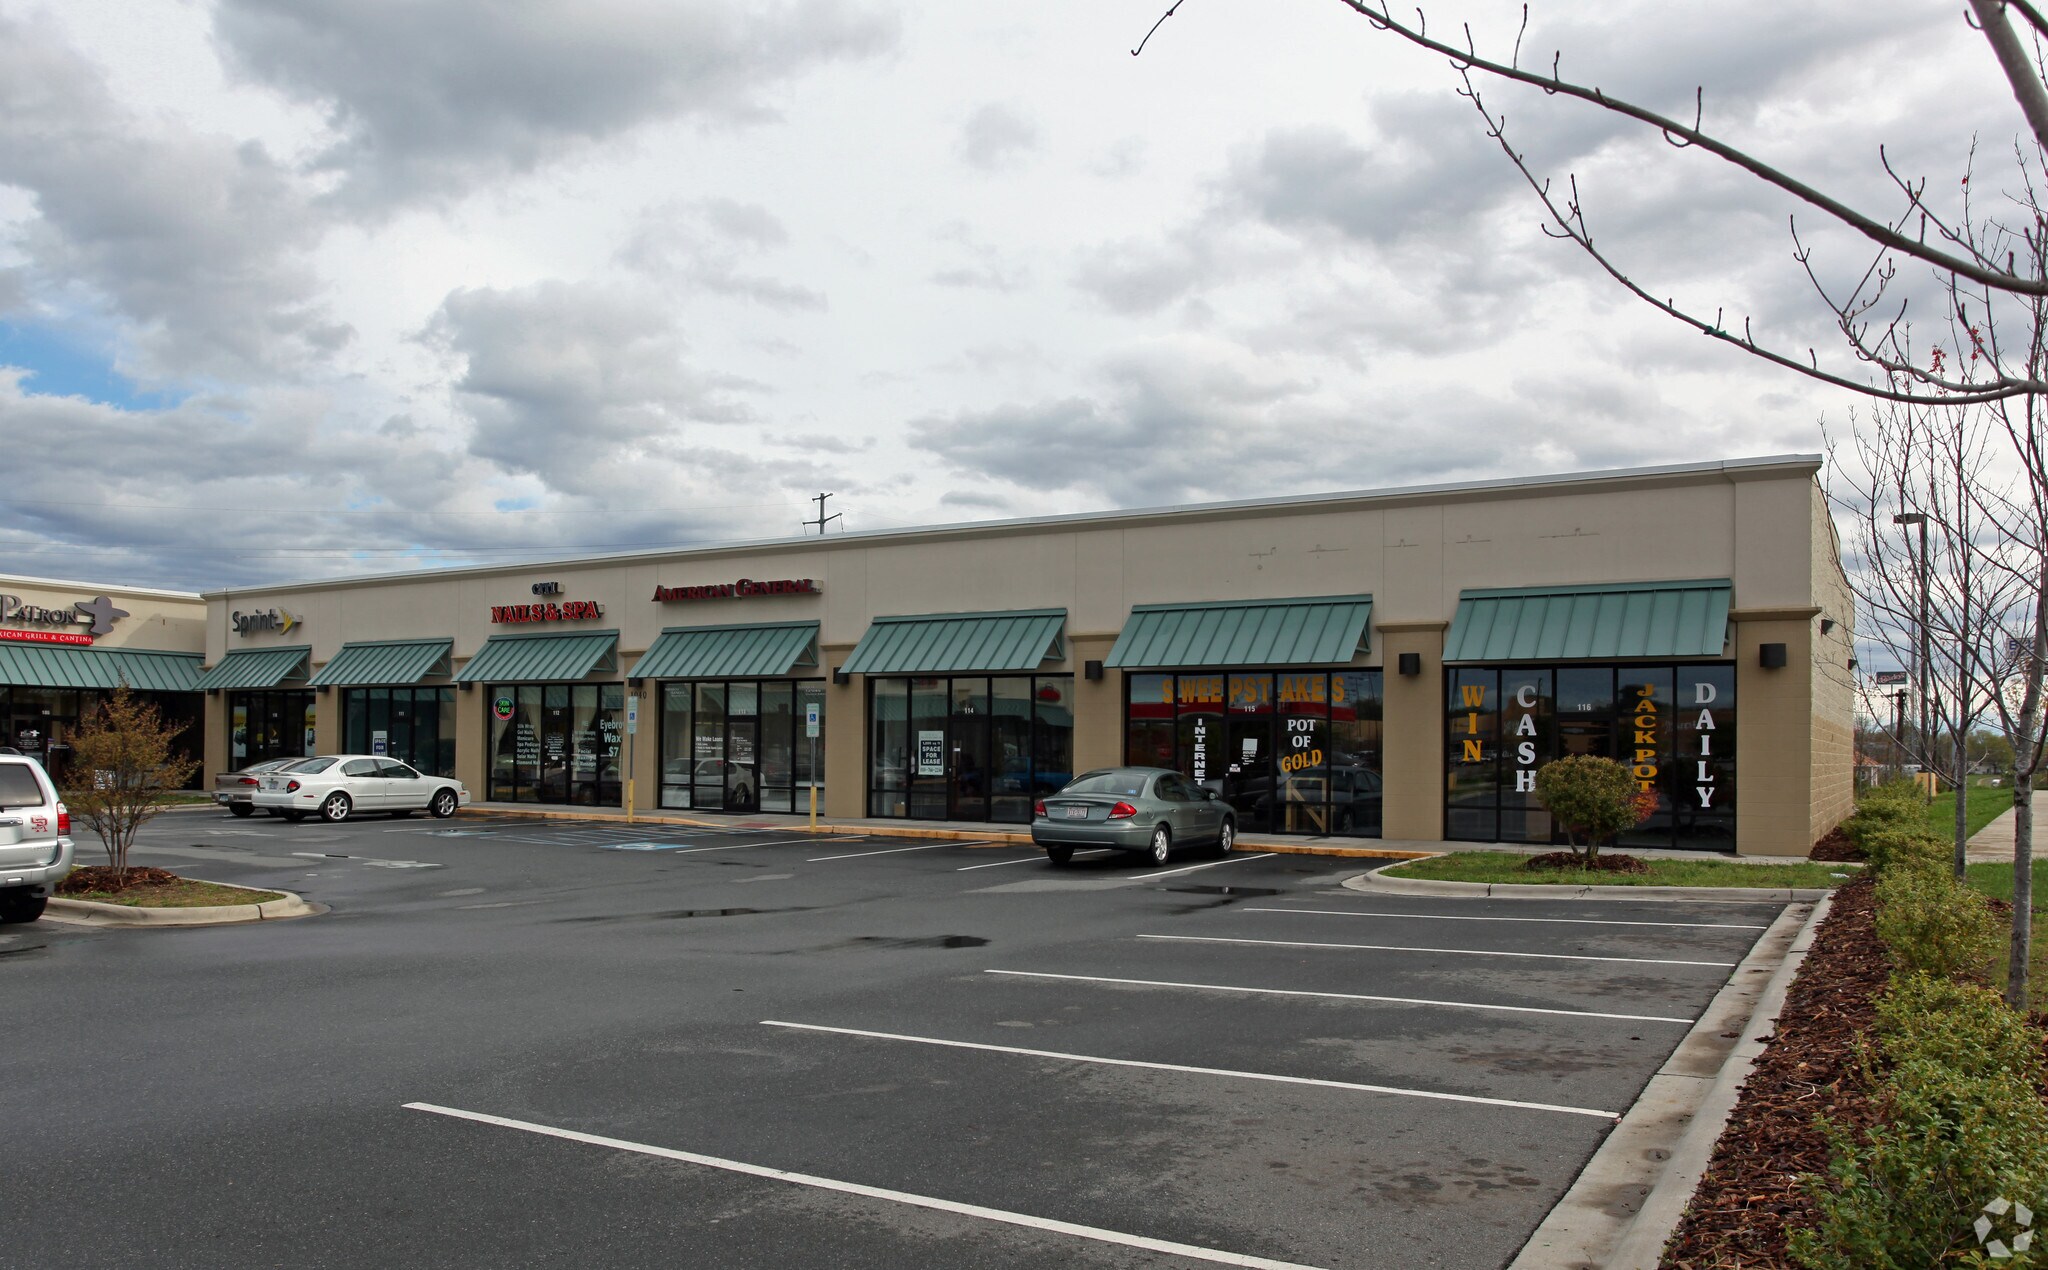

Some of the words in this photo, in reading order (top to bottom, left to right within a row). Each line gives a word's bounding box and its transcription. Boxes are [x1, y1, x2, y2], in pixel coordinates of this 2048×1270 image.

[651, 584, 733, 602] AMERICAN
[735, 578, 814, 597] GENERAL
[491, 604, 543, 623] NAILS
[562, 601, 599, 620] SPA
[232, 608, 279, 638] Sprint
[25, 632, 49, 640] GRILL
[60, 635, 93, 643] CANTINA
[1243, 705, 1256, 713] 115
[1577, 703, 1592, 711] 116
[600, 719, 624, 732] Eyebro
[1287, 719, 1317, 732] POT
[1461, 685, 1485, 762] WIN
[603, 732, 622, 743] Wax
[1292, 735, 1312, 748] OF
[1515, 685, 1537, 793] CASH
[1694, 683, 1717, 808] DAILY
[608, 746, 619, 758] $7
[1194, 718, 1206, 786] INTERNET
[1281, 749, 1323, 773] GOLD
